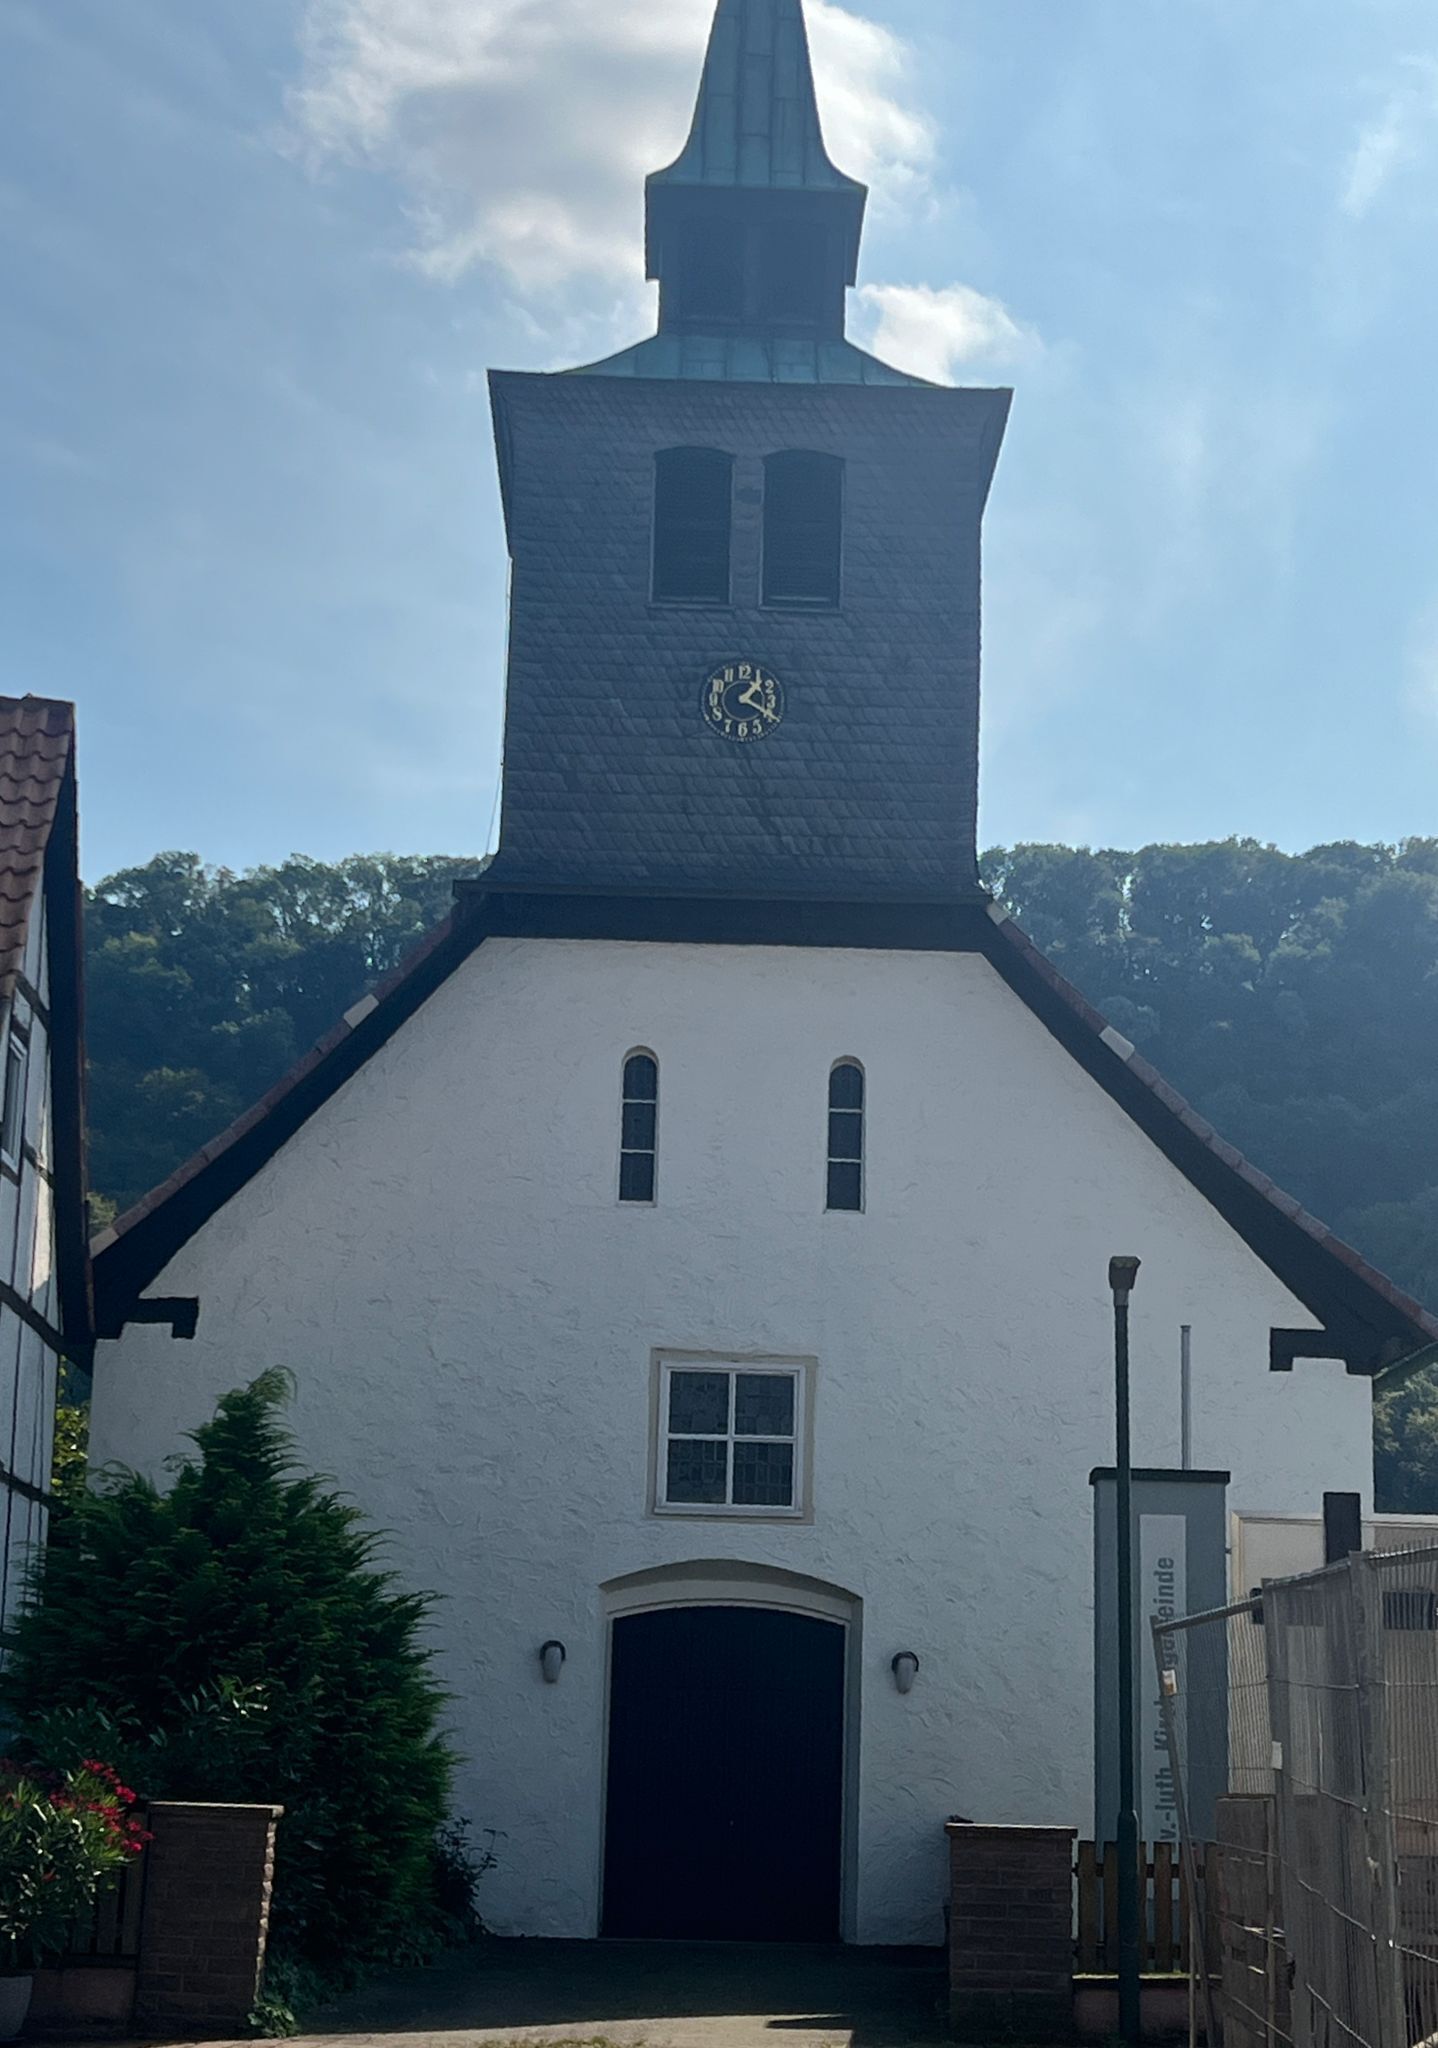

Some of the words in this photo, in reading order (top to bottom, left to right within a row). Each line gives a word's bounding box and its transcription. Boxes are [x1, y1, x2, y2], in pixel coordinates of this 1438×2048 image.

[724, 668, 733, 682] 11
[738, 664, 751, 679] 12
[712, 679, 724, 693] 10
[764, 679, 774, 694] 2
[766, 694, 776, 709] 3
[712, 706, 722, 721] 8
[724, 719, 732, 733] 7
[738, 722, 748, 737] 6
[752, 719, 762, 734] 5
